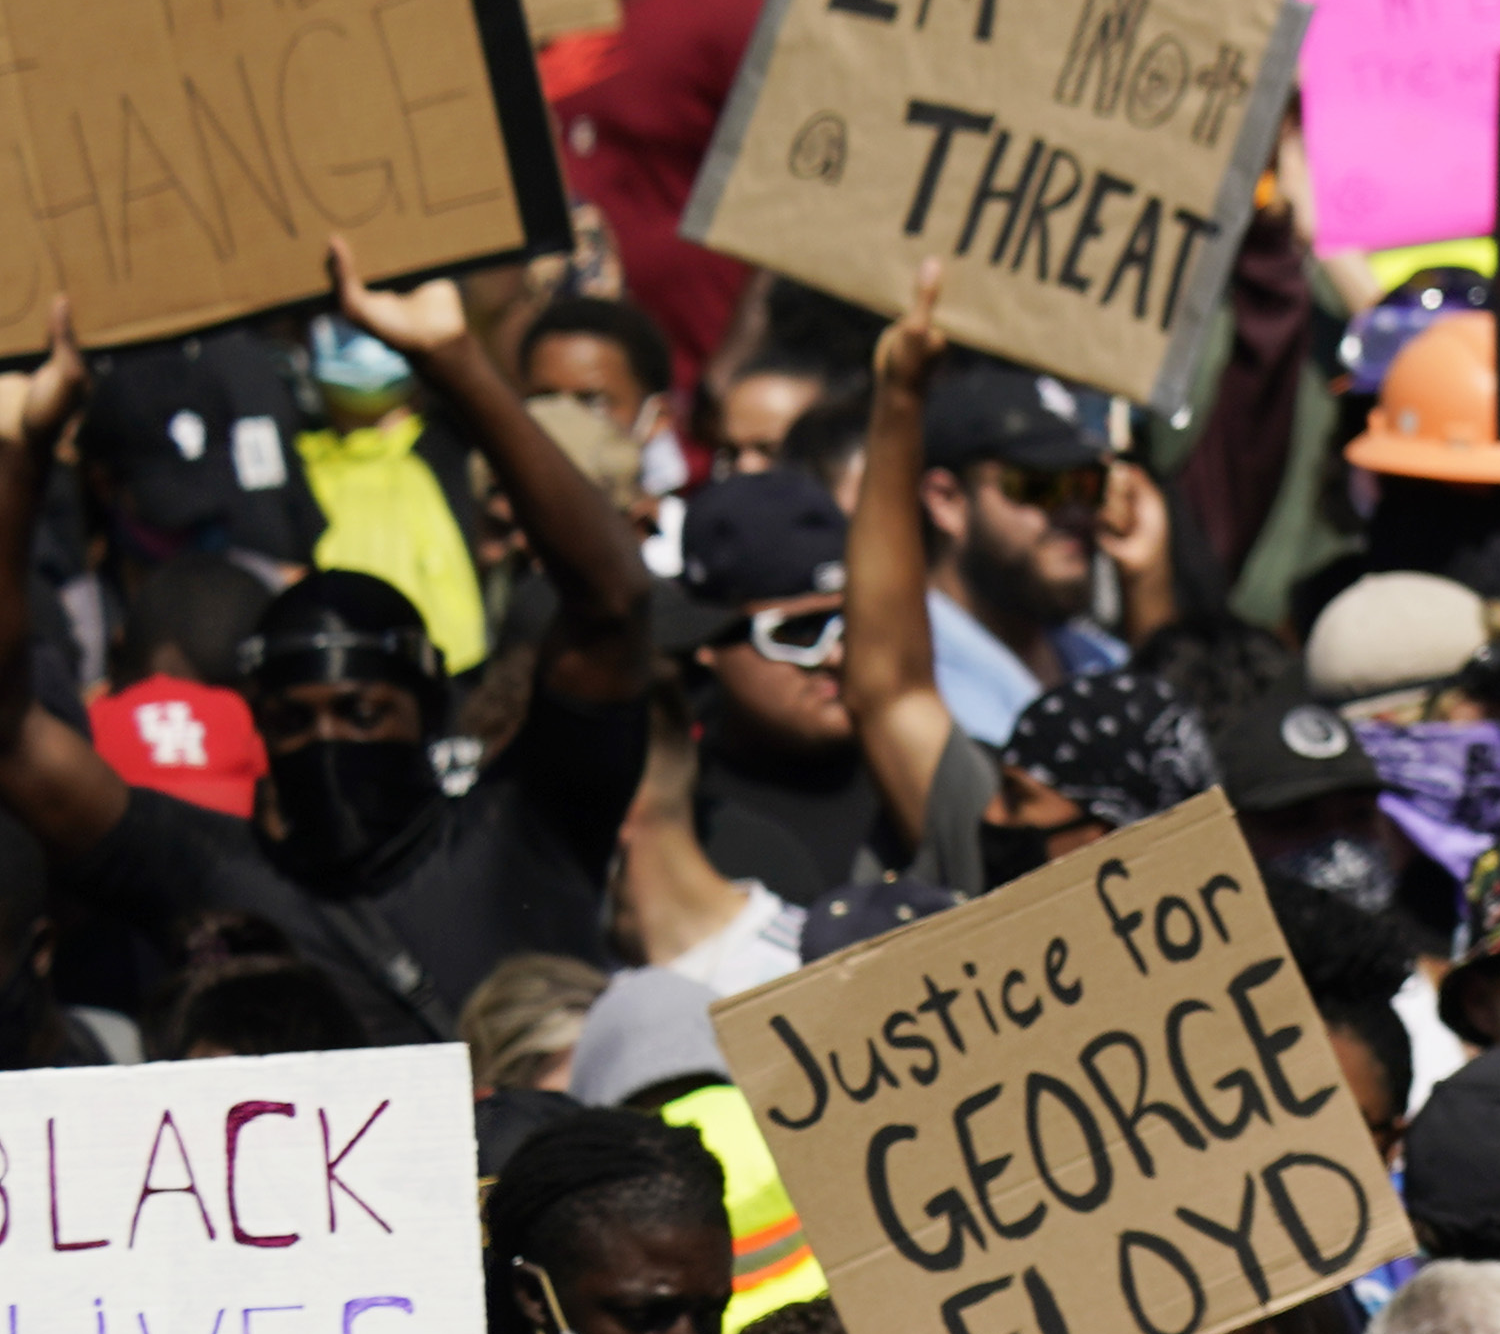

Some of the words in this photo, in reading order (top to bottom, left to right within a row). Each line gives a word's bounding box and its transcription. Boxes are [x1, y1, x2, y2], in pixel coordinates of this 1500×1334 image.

[905, 99, 1223, 332] THREAT
[767, 935, 1086, 1132] Justice
[1096, 856, 1242, 977] for
[866, 956, 1339, 1273] GEORGE
